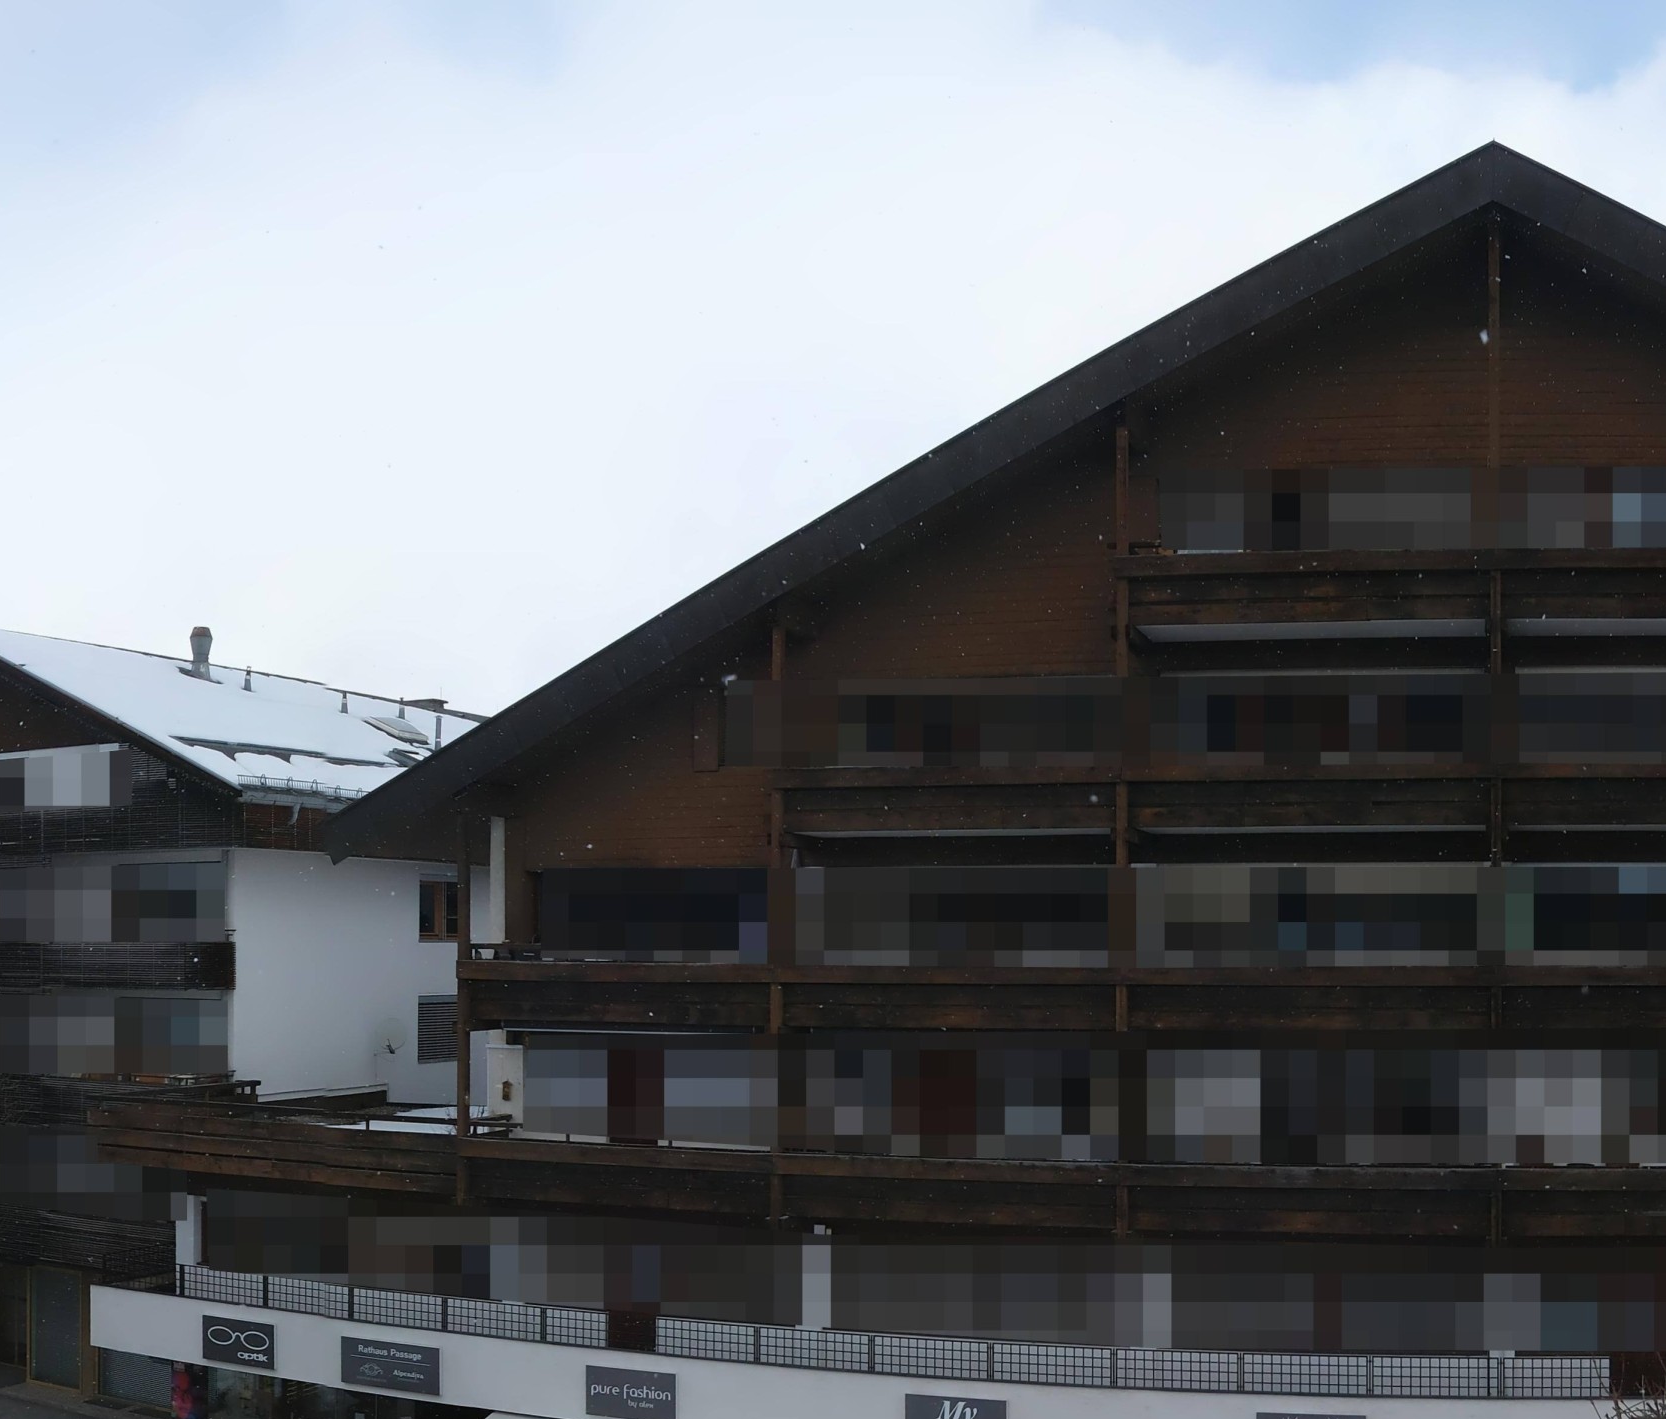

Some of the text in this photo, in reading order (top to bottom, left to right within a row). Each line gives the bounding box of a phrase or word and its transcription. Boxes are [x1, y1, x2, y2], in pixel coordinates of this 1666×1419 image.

[237, 1351, 269, 1362] optik
[358, 1344, 422, 1361] Rathaus Passage
[590, 1383, 671, 1401] pure fashion
[628, 1399, 654, 1409] by alex
